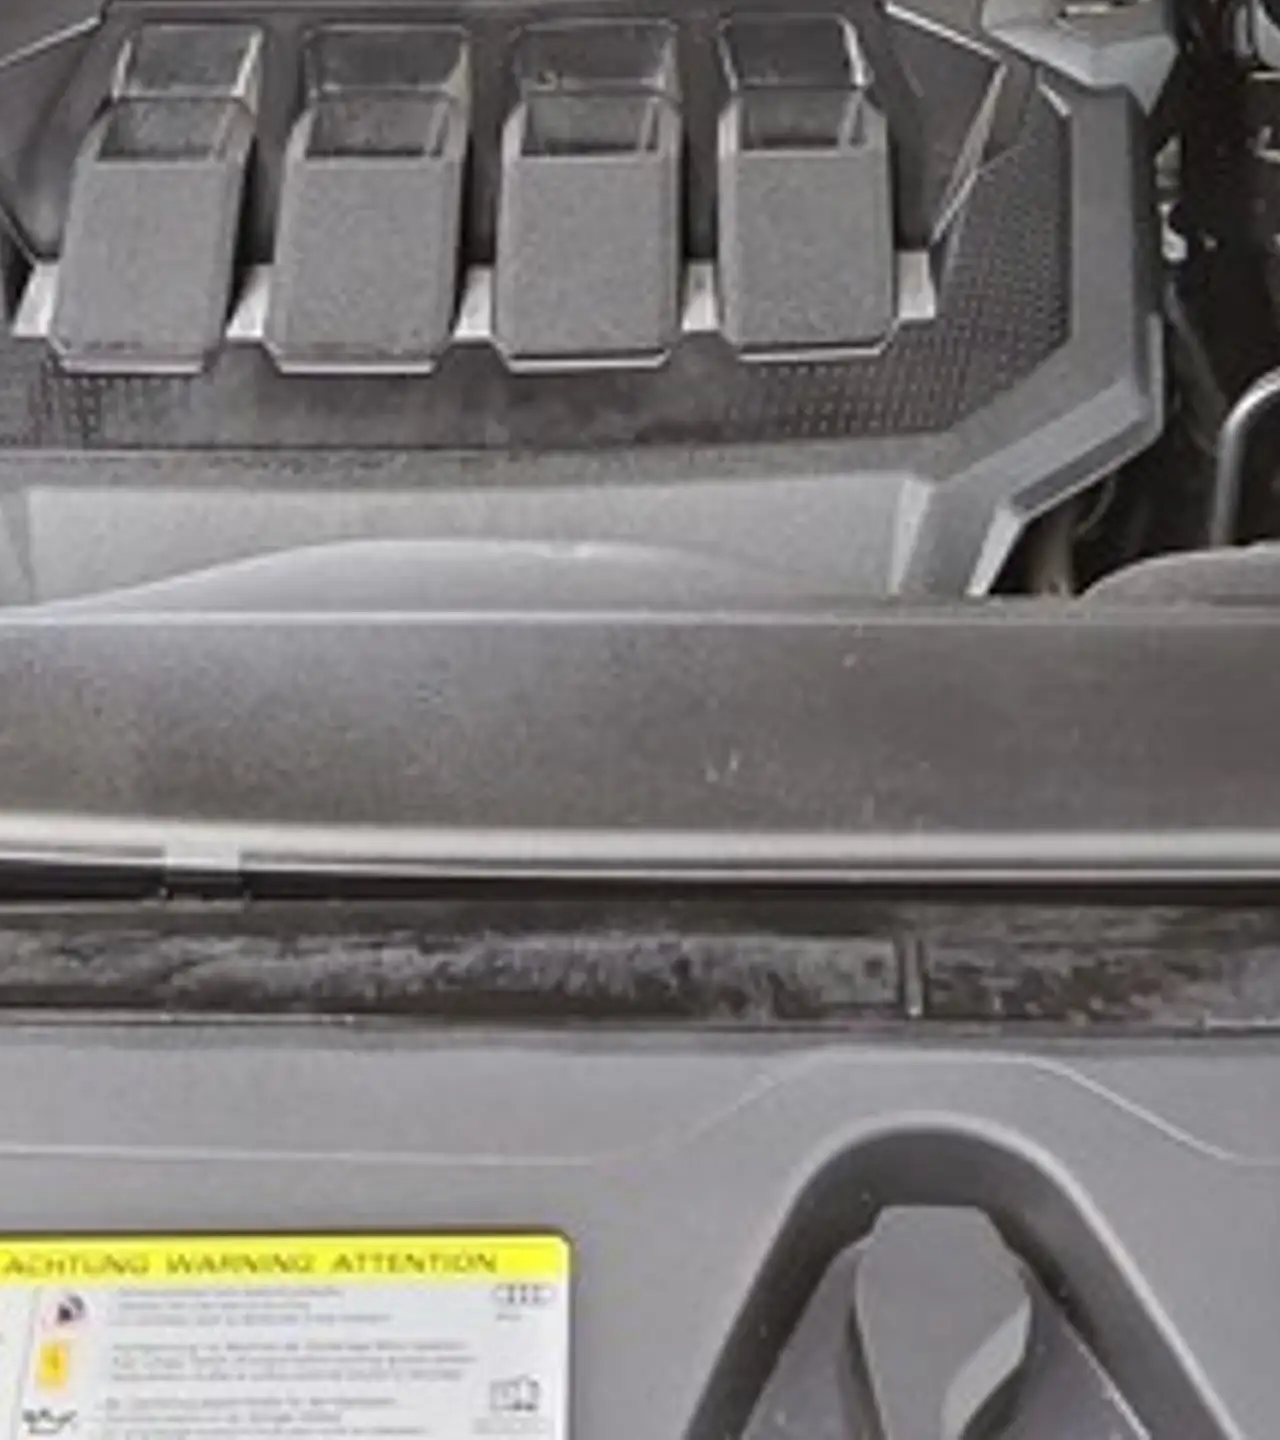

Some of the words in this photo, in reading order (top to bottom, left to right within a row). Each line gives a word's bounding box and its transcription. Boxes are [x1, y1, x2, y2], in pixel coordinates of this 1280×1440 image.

[3, 1252, 150, 1276] ACHTUNG
[166, 1252, 315, 1275] WARNING
[330, 1251, 499, 1274] ATTENTION
